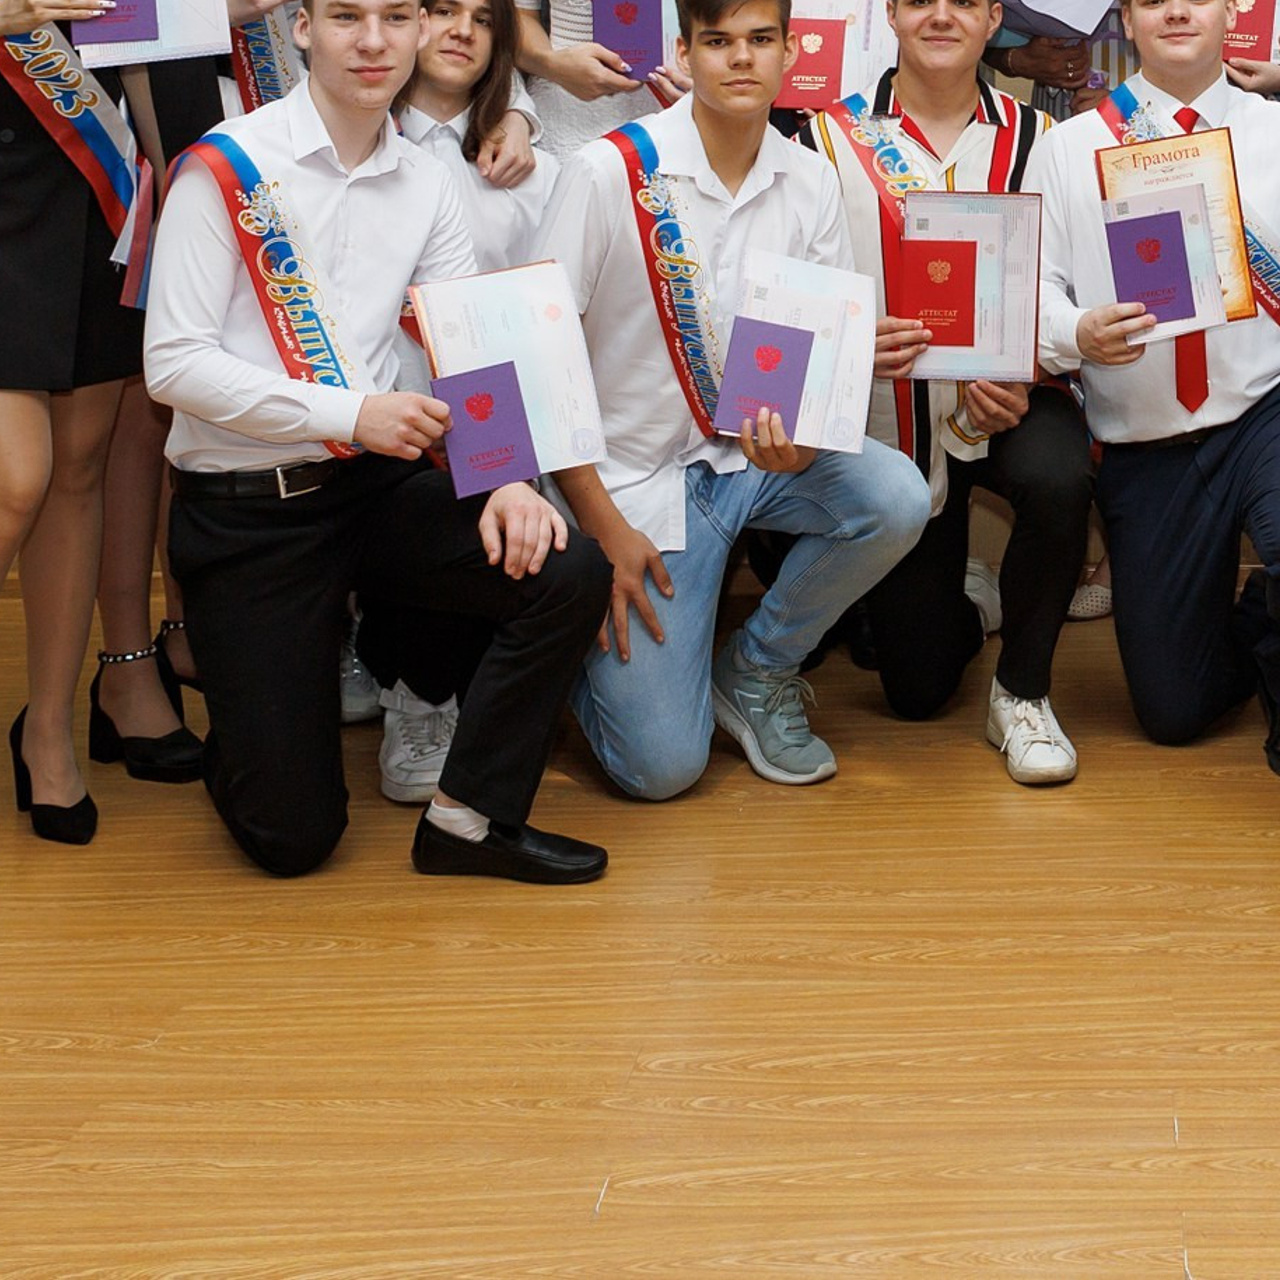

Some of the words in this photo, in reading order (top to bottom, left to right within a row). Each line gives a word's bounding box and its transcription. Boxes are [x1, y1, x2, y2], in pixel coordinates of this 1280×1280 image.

[5, 29, 99, 118] 2023
[791, 74, 828, 83] АТТЕСТАТ
[1131, 145, 1201, 171] Грамота
[256, 236, 344, 386] Выпус
[917, 309, 959, 318] АТТЕСТАТ
